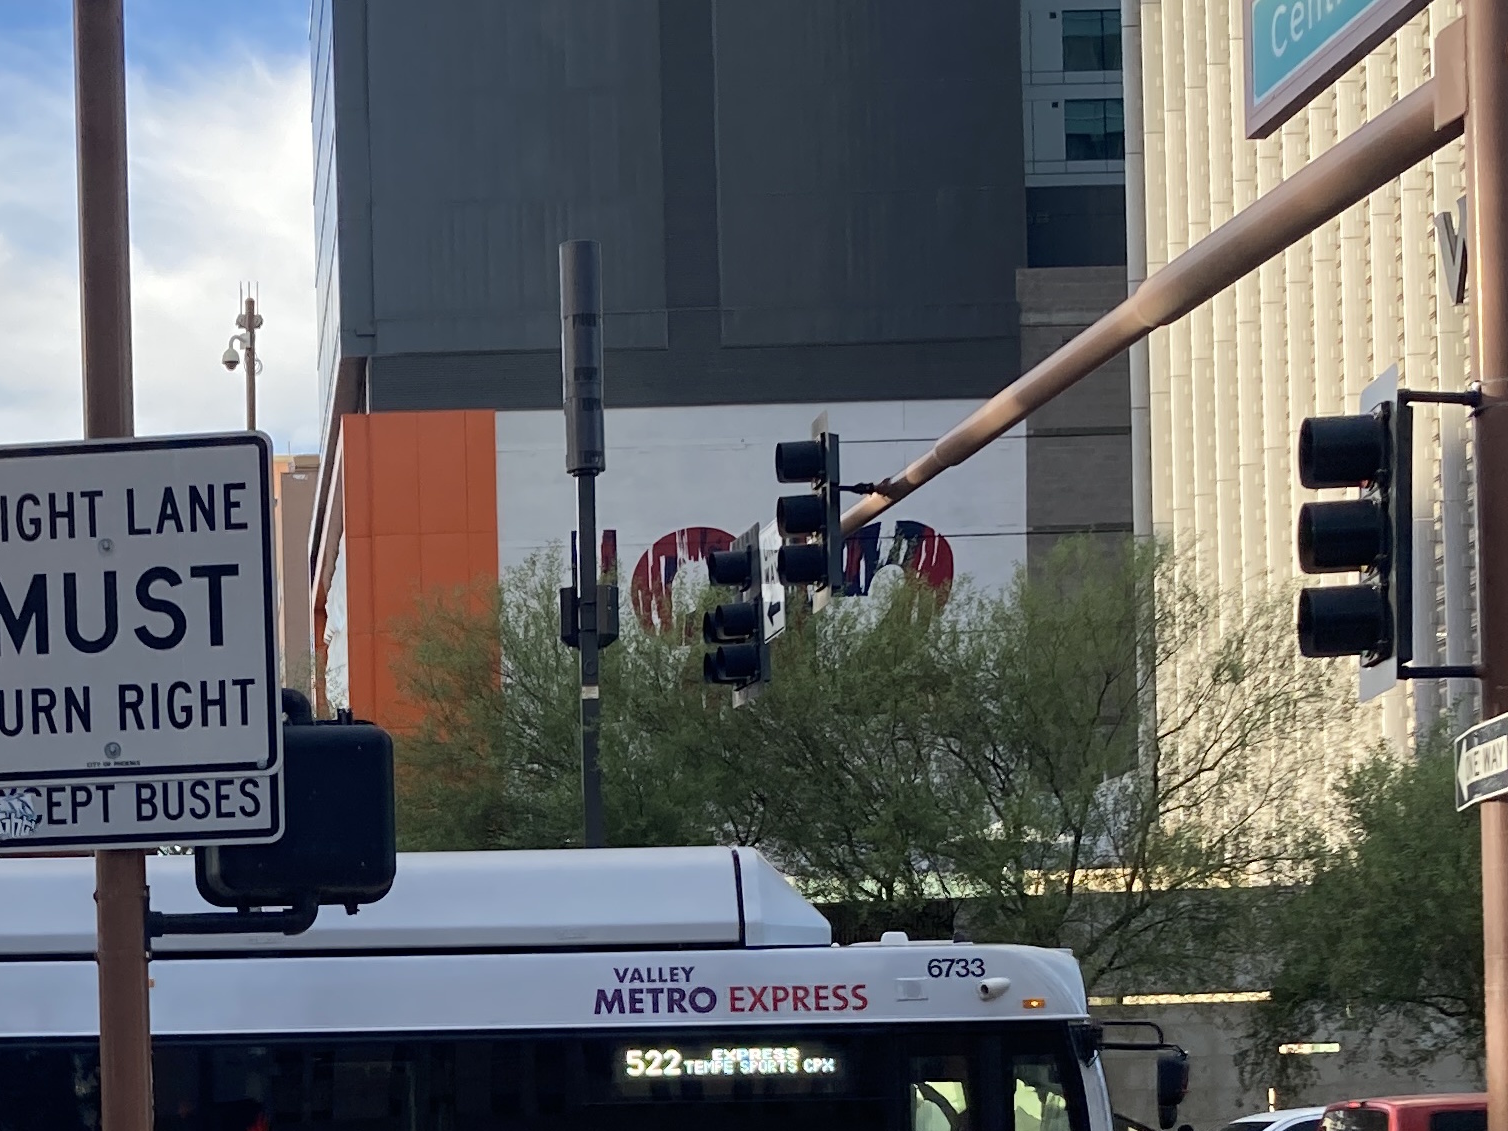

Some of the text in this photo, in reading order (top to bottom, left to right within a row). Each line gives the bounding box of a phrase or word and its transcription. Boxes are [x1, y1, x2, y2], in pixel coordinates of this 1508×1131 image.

[126, 482, 248, 535] LANE
[118, 679, 255, 730] RIGHT
[1483, 741, 1504, 773] WAY
[136, 778, 261, 822] BUSES
[613, 966, 695, 984] VALLEY
[927, 958, 986, 978] 6733
[594, 984, 868, 1015] METRO EXPRESS
[625, 1048, 683, 1077] 522
[683, 1060, 733, 1075] TEMPE
[740, 1059, 798, 1075] SPORTS
[711, 1047, 800, 1061] EXPRESS
